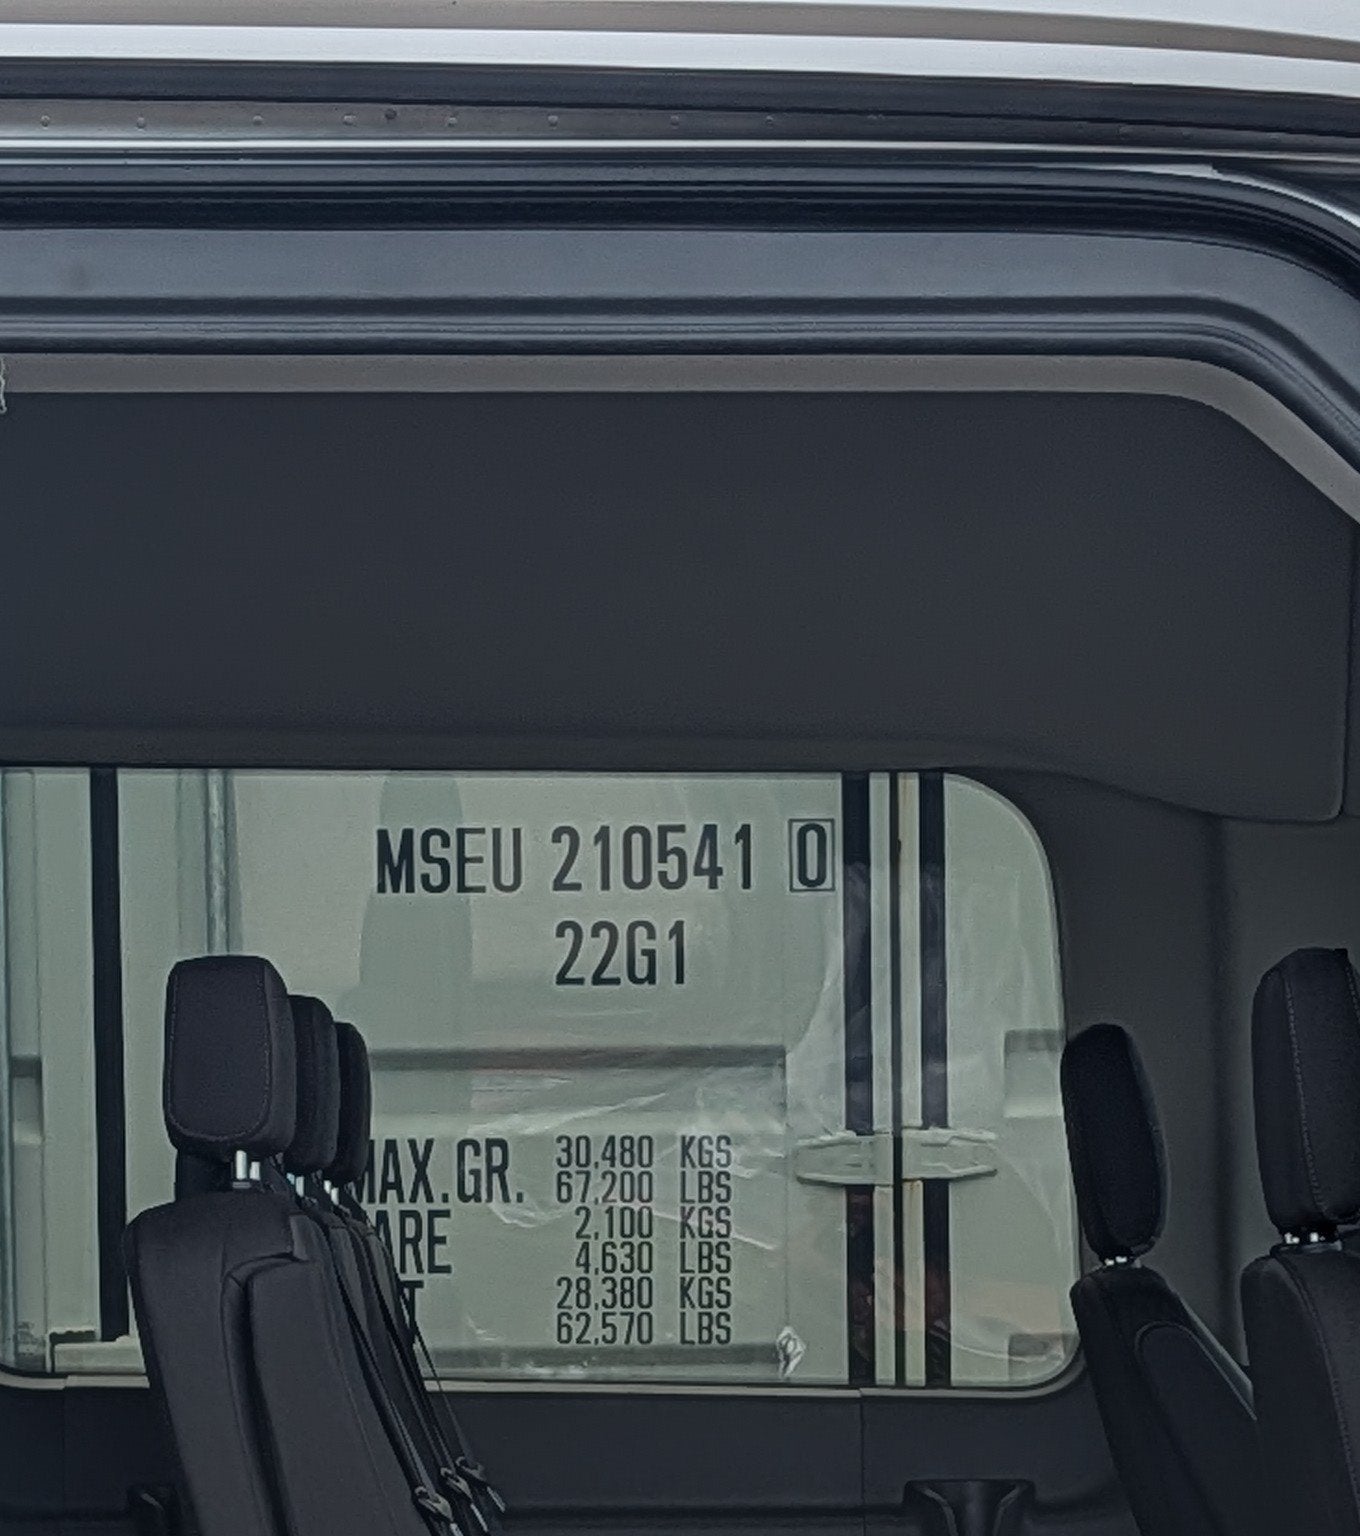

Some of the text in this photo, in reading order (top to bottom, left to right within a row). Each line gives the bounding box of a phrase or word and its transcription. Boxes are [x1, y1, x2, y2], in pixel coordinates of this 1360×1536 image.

[376, 826, 523, 894] MSEU
[551, 823, 752, 892] 210541
[554, 919, 686, 987] 22G1
[555, 1134, 654, 1168] 30,480
[679, 1134, 733, 1169] KGS
[555, 1169, 733, 1204] 67,200 LBS
[574, 1206, 654, 1240] 2,100
[679, 1205, 733, 1239] KGS
[574, 1241, 733, 1276] 4,630 LBS
[555, 1276, 733, 1311] 28,380 KGS
[555, 1311, 733, 1346] 62,570 LBS
